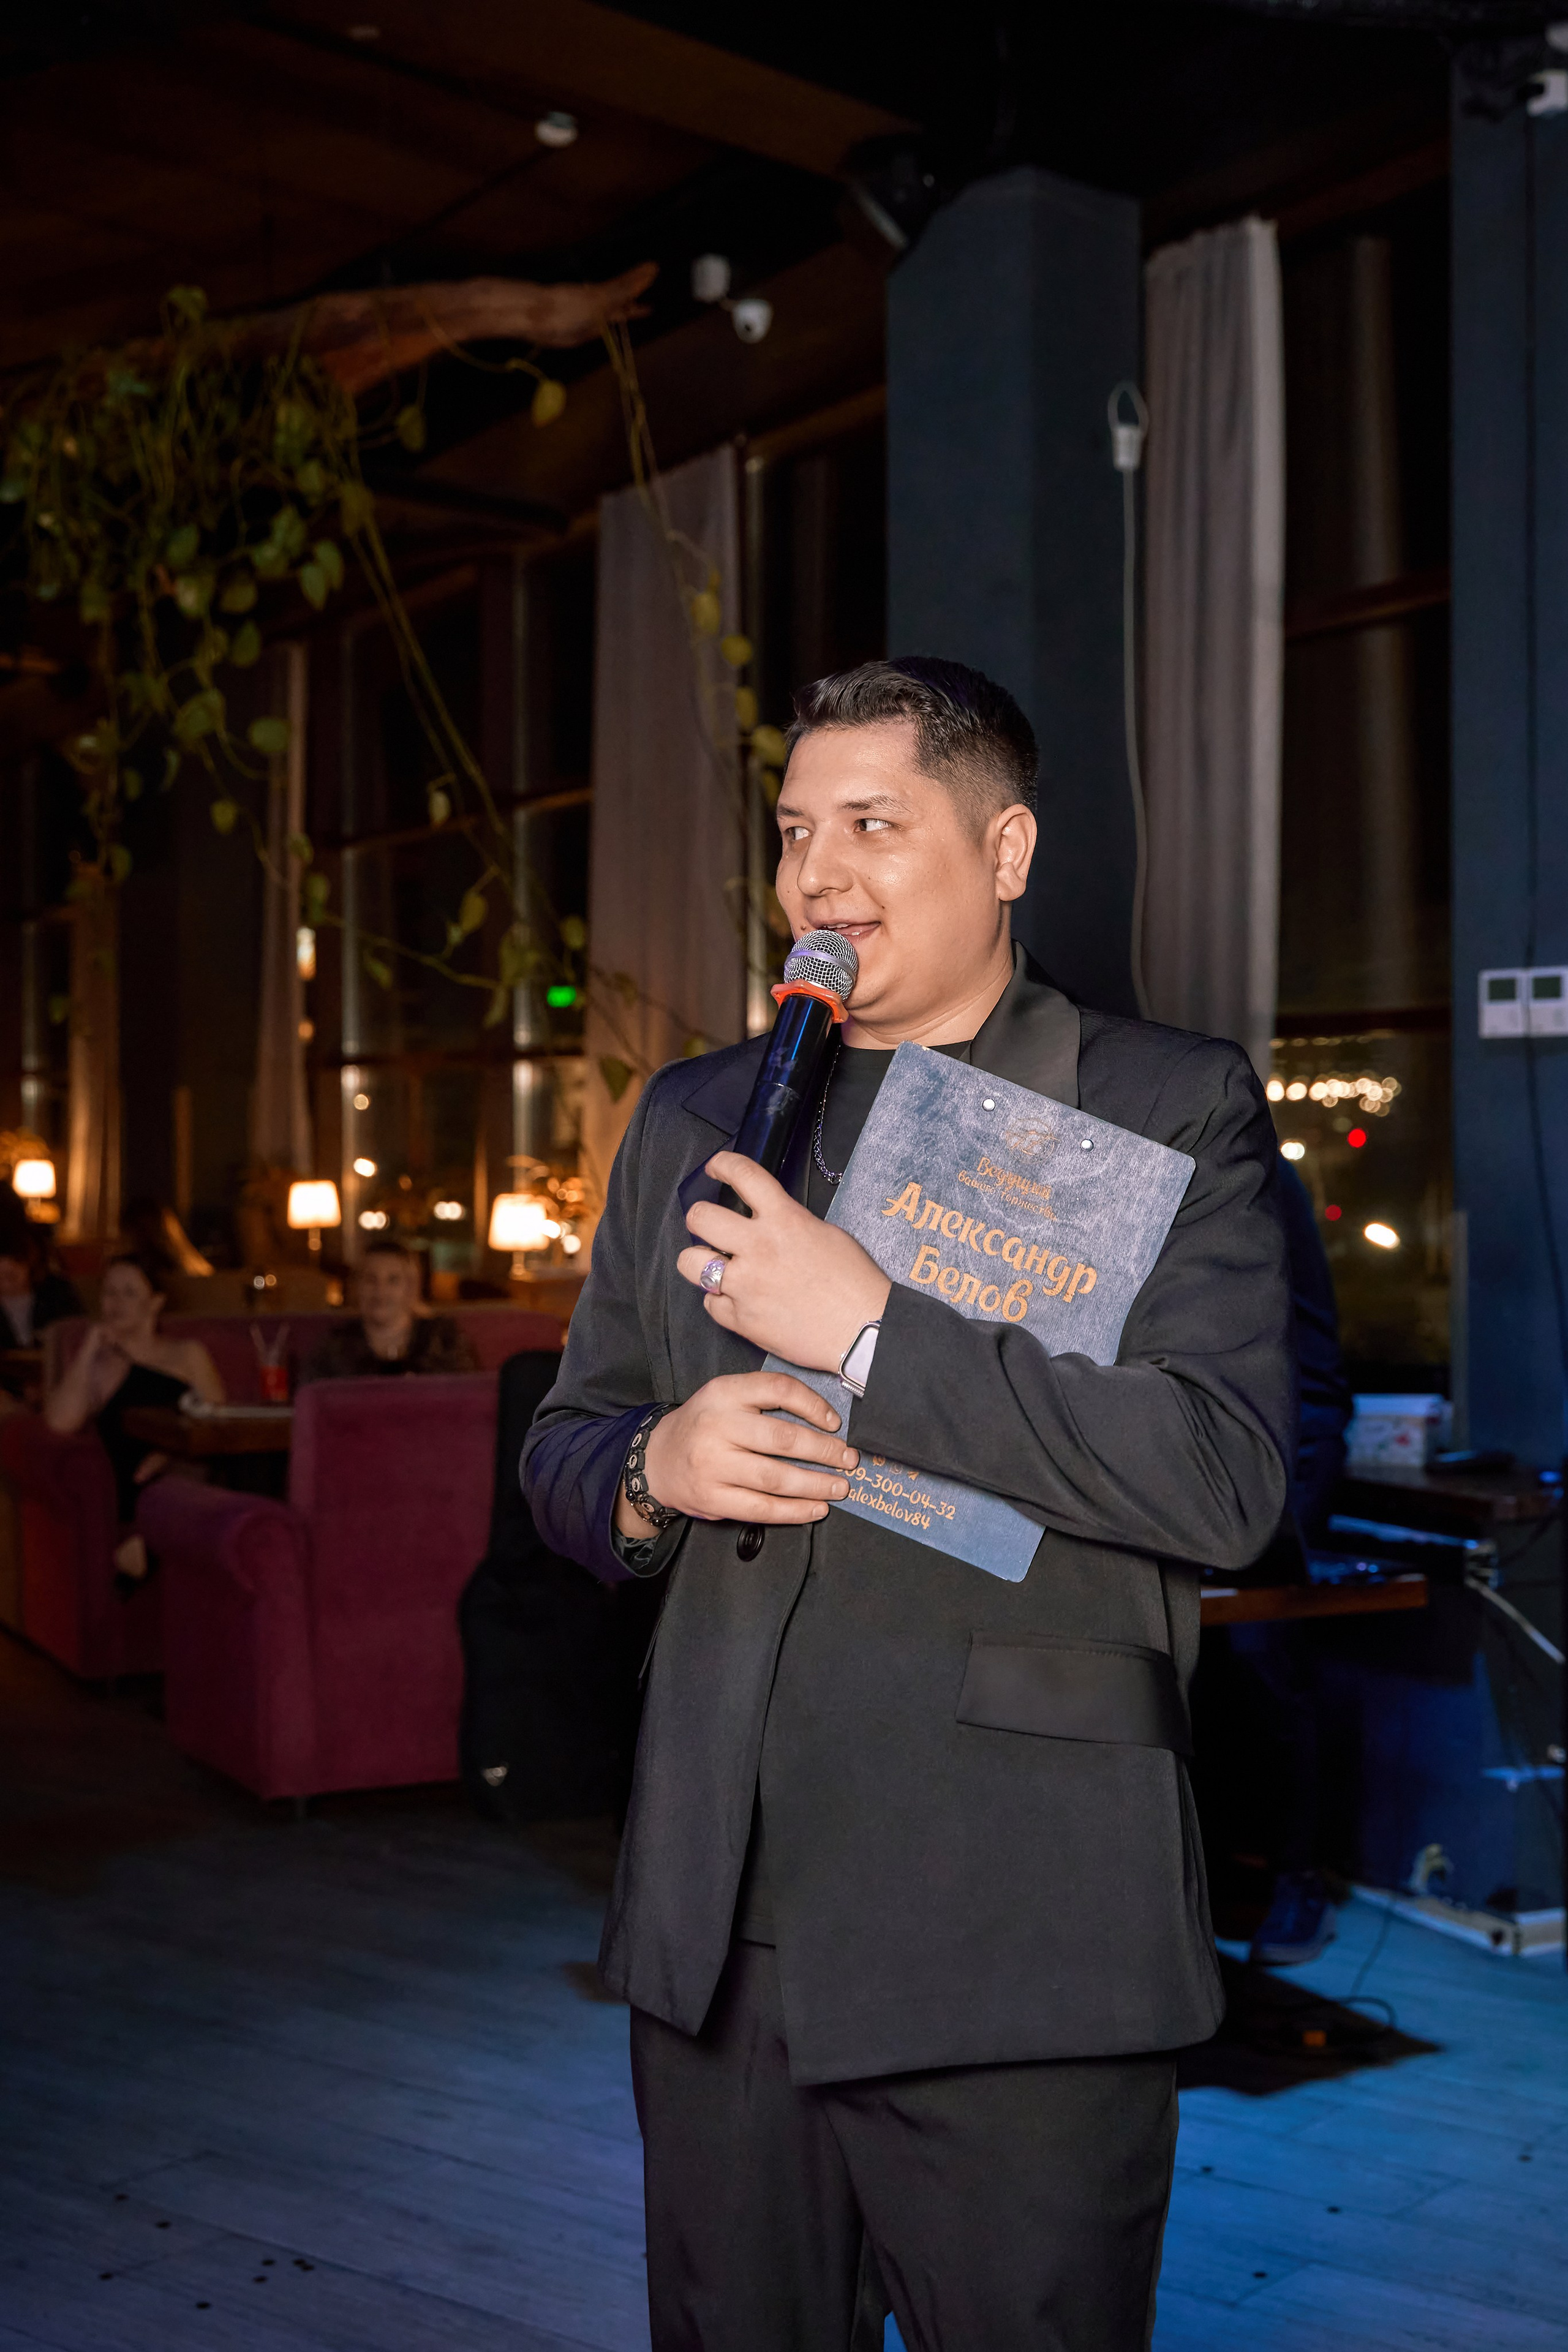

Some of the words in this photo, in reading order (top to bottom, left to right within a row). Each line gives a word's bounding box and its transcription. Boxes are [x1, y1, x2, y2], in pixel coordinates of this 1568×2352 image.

[977, 1156, 1052, 1199] Ведущий
[881, 1182, 1098, 1303] Александр
[909, 1244, 1033, 1322] Белов
[836, 1467, 956, 1520] 9-300-04-32
[848, 1486, 931, 1530] alexbelov84
